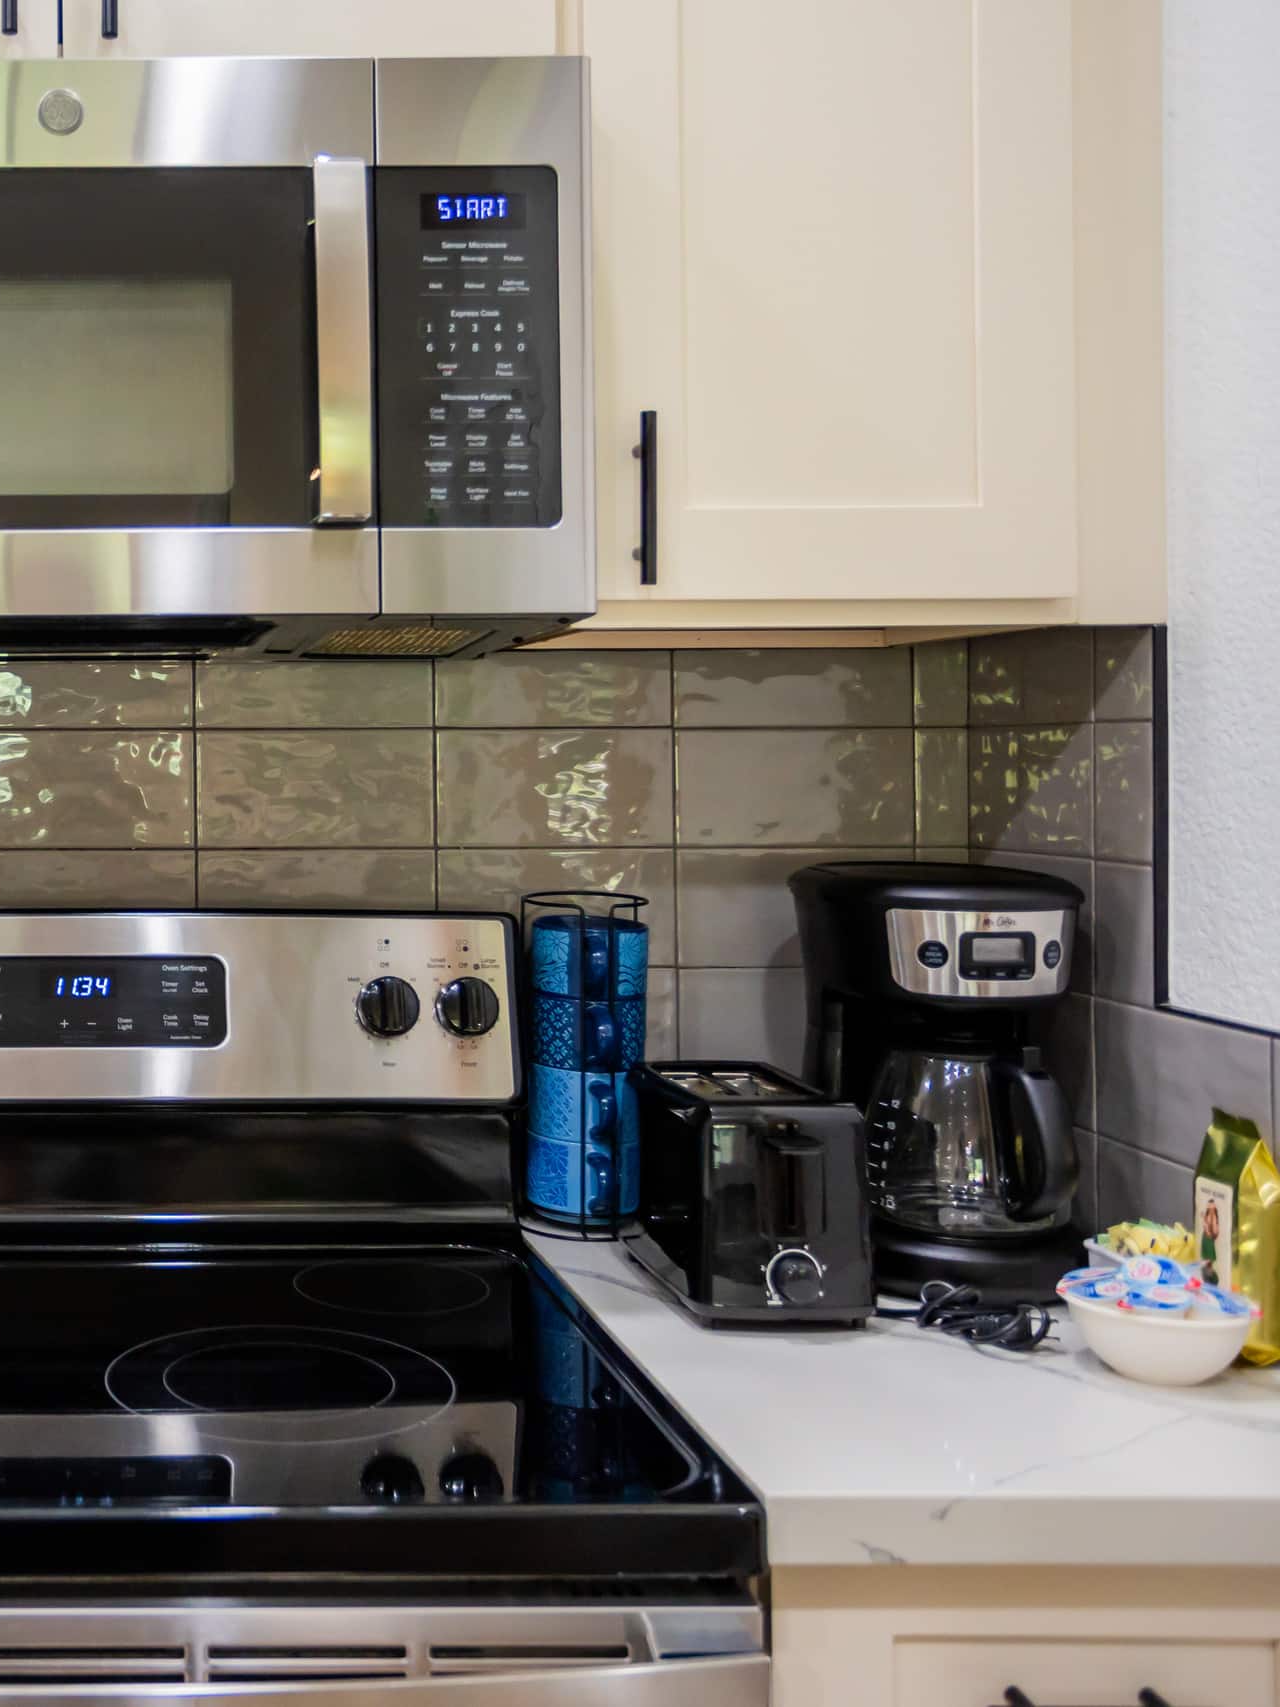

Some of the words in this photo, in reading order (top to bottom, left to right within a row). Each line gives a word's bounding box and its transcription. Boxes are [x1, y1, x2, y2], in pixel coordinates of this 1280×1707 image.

[437, 197, 506, 220] START
[427, 323, 432, 333] 1
[448, 323, 456, 333] 2
[471, 323, 479, 333] 3
[494, 323, 501, 332] 4
[517, 322, 524, 333] 5
[426, 343, 433, 352] 6
[449, 343, 456, 352] 7
[471, 343, 479, 352] 8
[494, 342, 502, 352] 9
[517, 343, 525, 352] 0
[161, 964, 179, 972] Oven
[180, 964, 207, 973] Settings
